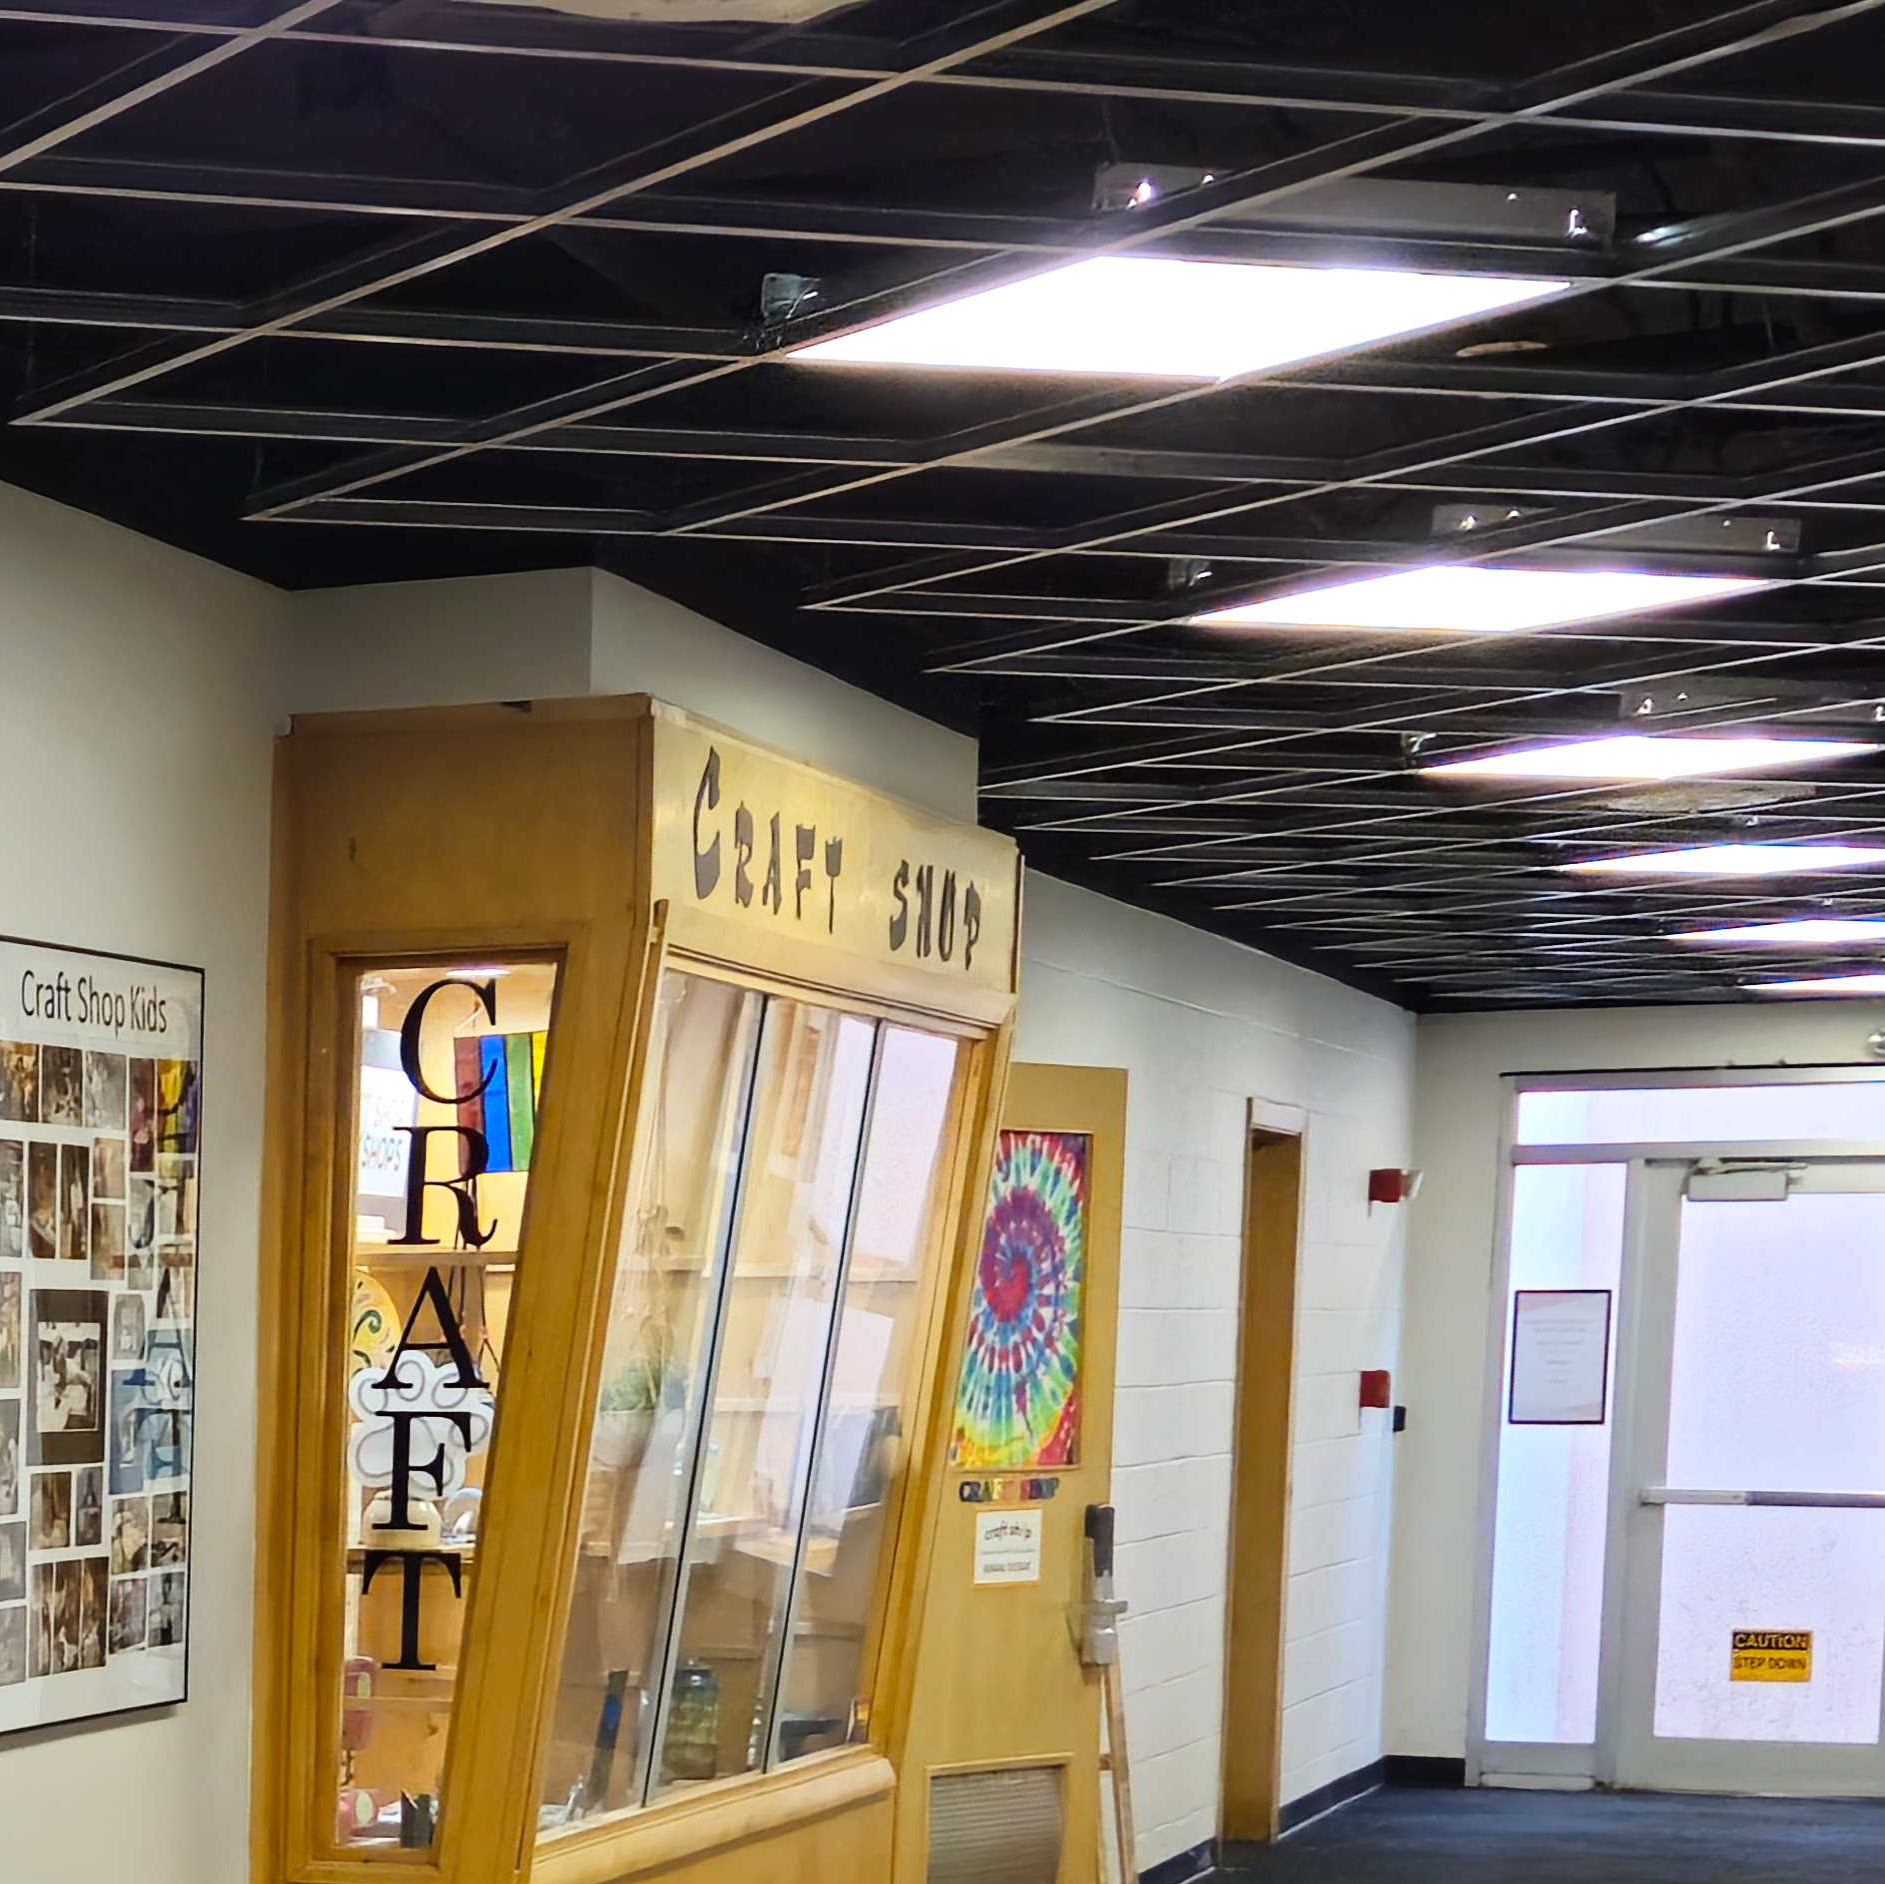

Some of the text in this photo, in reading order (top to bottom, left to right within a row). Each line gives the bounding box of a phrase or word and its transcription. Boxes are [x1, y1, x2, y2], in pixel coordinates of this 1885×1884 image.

[692, 744, 982, 972] CRAFT SHOP
[21, 969, 168, 1039] Craft Shop Kids
[361, 976, 499, 1672] CRAFT
[1734, 1633, 1807, 1648] CAUTION
